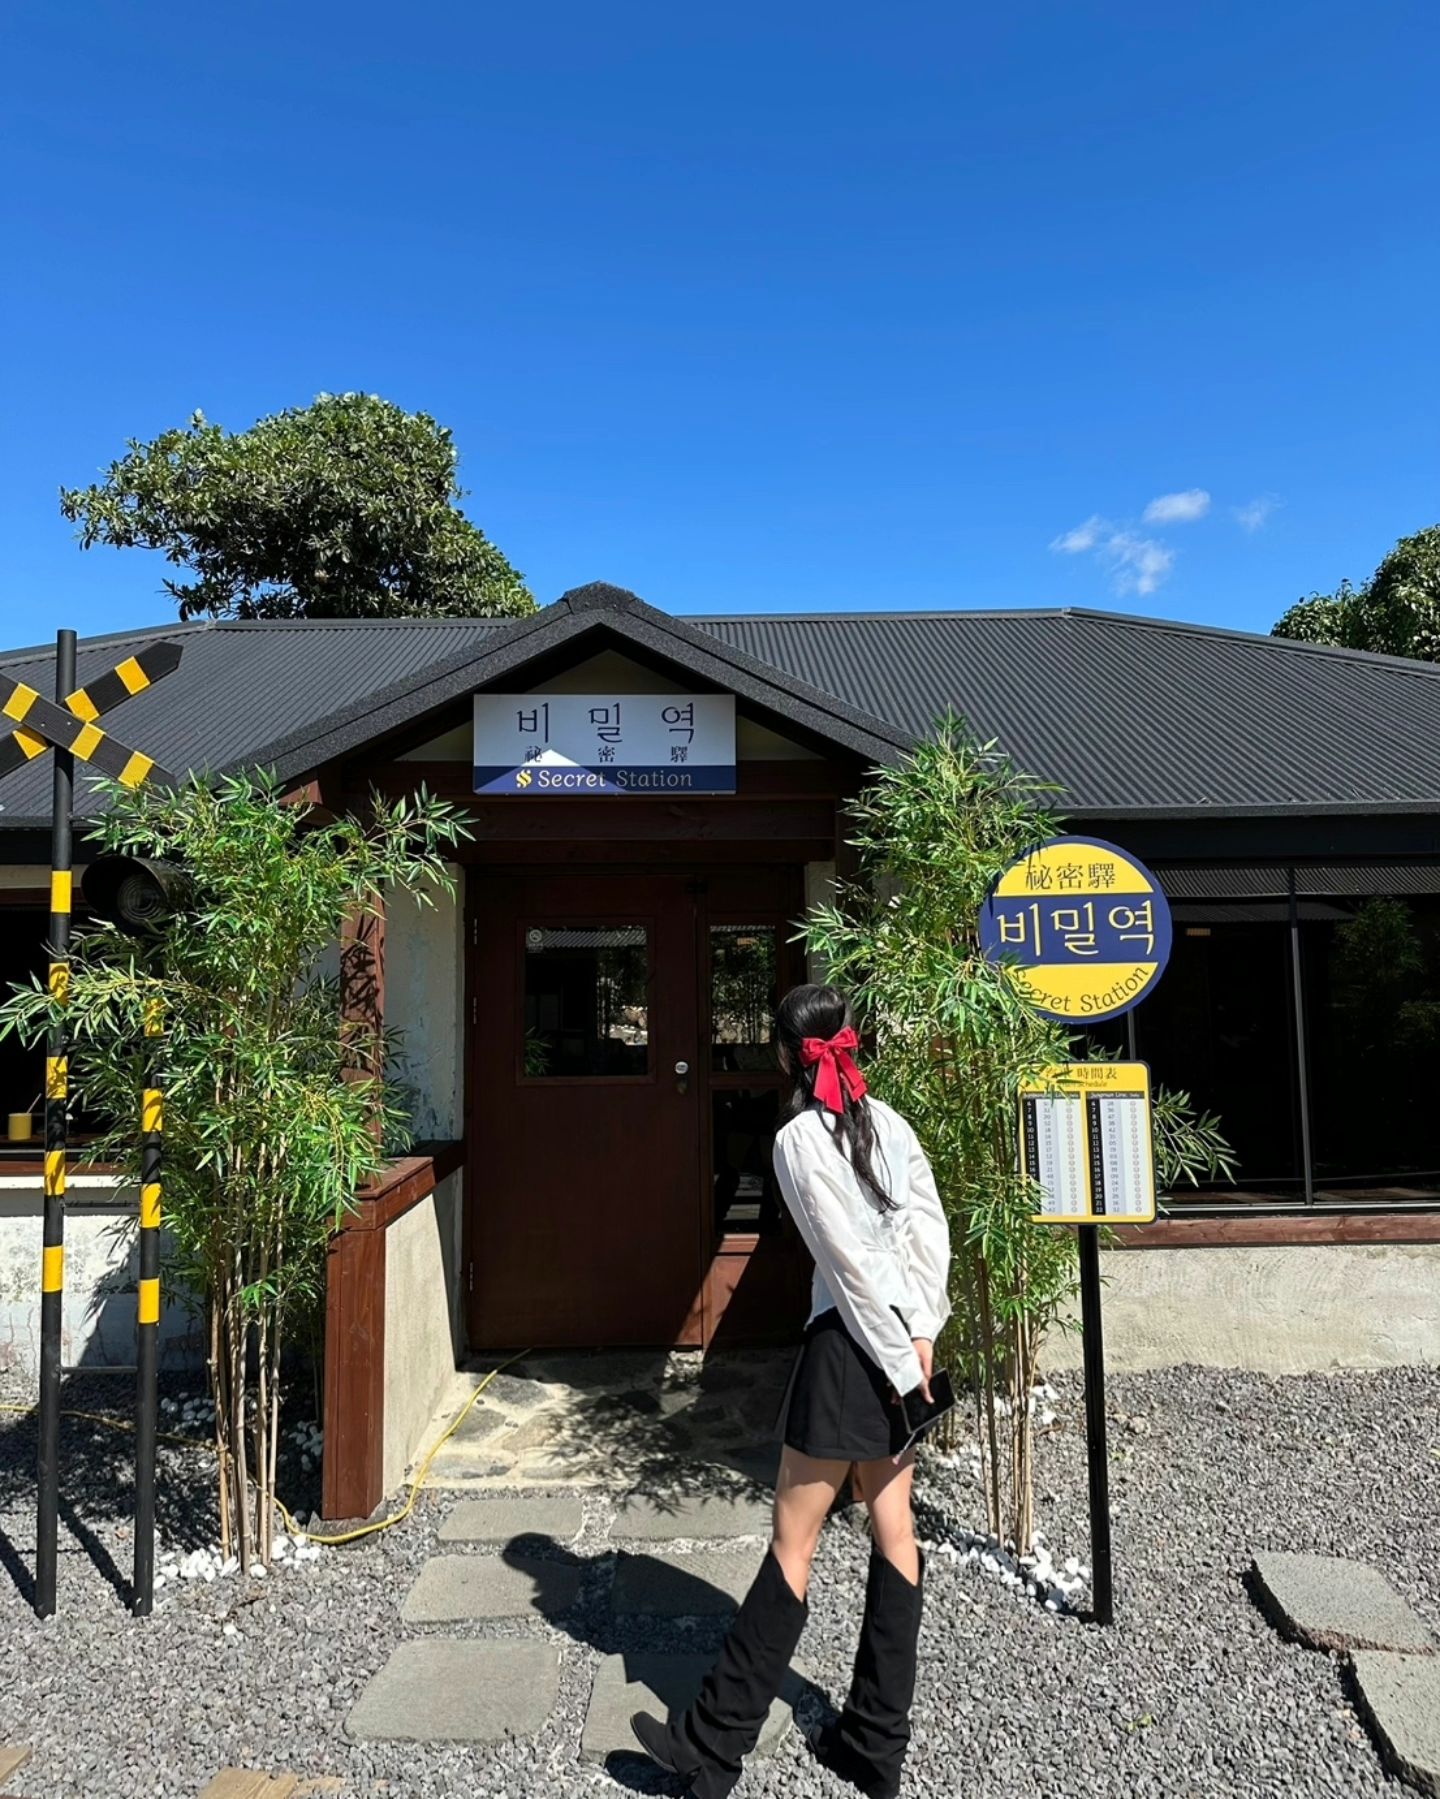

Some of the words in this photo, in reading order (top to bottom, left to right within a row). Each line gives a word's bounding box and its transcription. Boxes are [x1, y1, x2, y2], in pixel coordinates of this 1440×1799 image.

[516, 702, 695, 744] 비밀역
[537, 769, 607, 788] Secret
[615, 769, 693, 788] Station
[996, 899, 1156, 957] 비밀역
[1080, 966, 1149, 1013] Station
